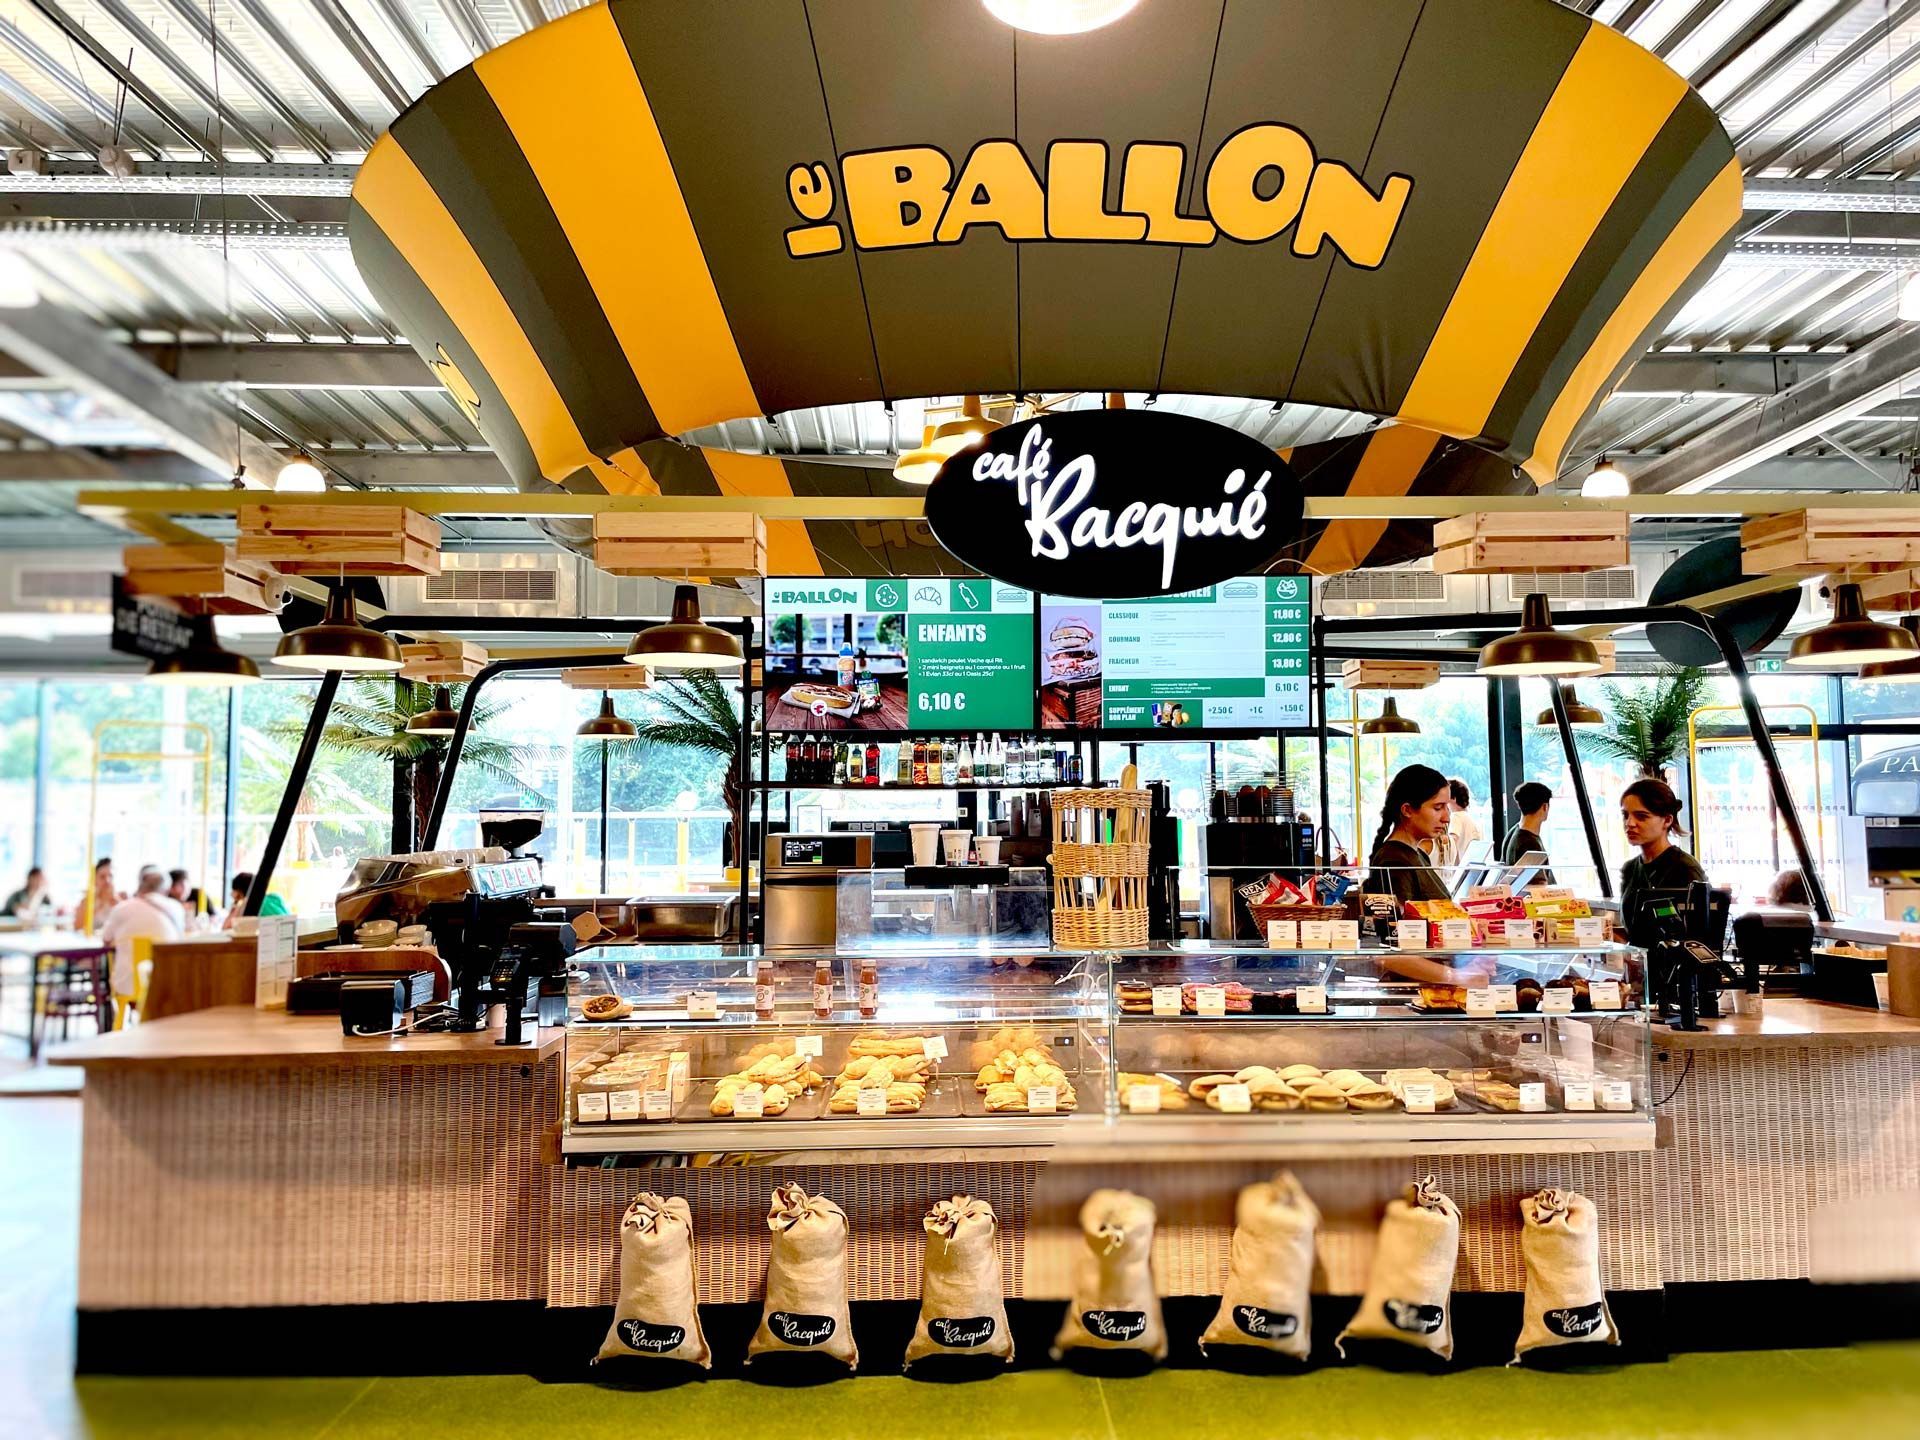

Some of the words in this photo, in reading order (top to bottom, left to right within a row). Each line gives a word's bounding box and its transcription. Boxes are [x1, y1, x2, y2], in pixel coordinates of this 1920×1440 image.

[784, 159, 846, 260] le
[837, 121, 1416, 271] BALLON
[972, 423, 1053, 506] café
[1024, 454, 1272, 590] Bacquié
[782, 588, 857, 604] BALLON
[1108, 612, 1139, 620] CLASSIQUE
[918, 624, 987, 643] ENFANTS
[1293, 683, 1299, 691] €
[918, 692, 952, 712] 6,10
[954, 692, 966, 710] €
[1880, 755, 1920, 774] PA
[632, 1329, 682, 1353] Bacquié
[784, 1320, 832, 1346] Bacquié
[944, 1320, 992, 1347] Bacquié
